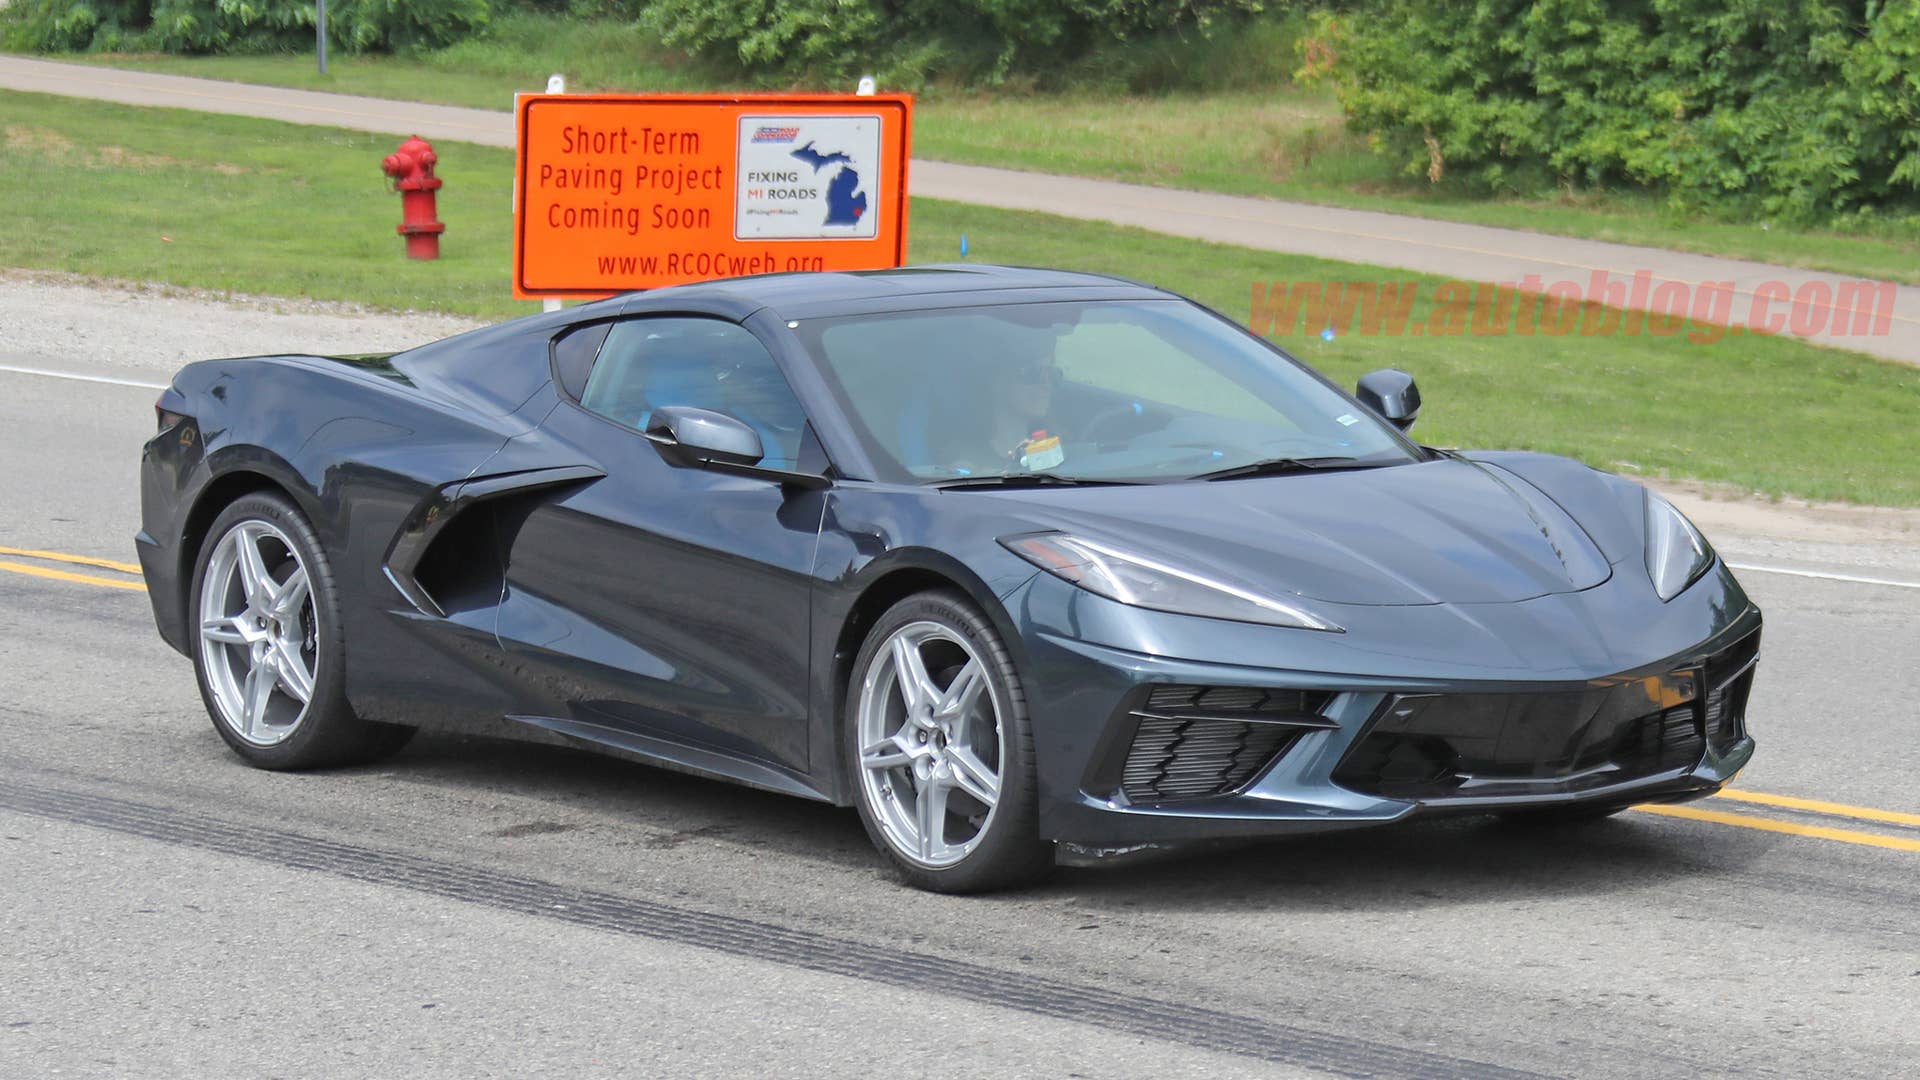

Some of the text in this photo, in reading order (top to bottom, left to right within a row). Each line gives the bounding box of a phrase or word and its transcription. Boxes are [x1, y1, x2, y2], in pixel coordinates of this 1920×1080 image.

[562, 125, 700, 154] Short-Term
[540, 163, 722, 196] Paving Project
[747, 172, 798, 183] FIXING
[747, 189, 817, 199] MI ROADS
[548, 201, 710, 236] Coming Soon
[598, 252, 823, 276] www.RCOCweborg
